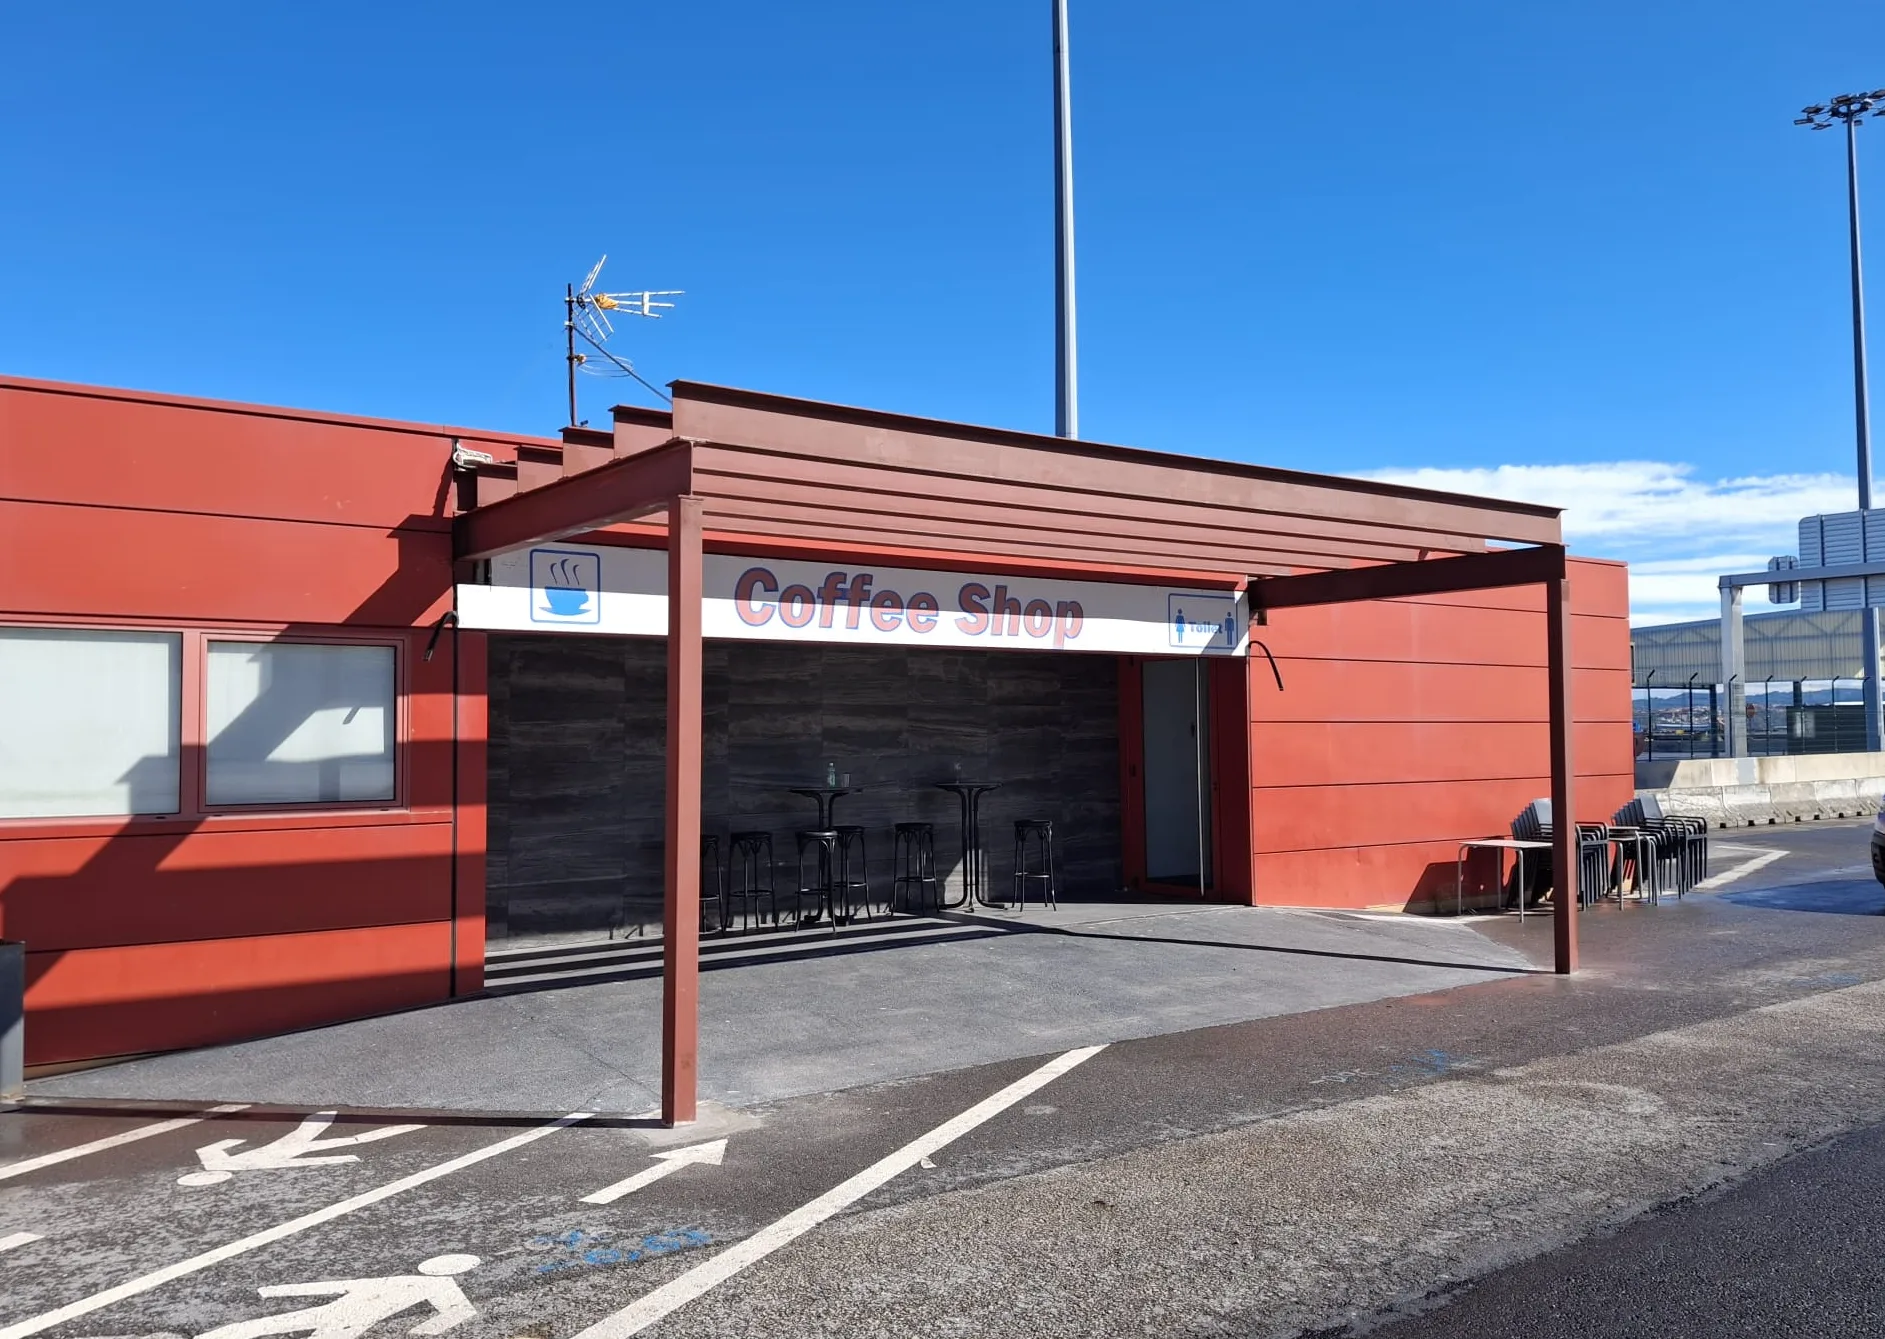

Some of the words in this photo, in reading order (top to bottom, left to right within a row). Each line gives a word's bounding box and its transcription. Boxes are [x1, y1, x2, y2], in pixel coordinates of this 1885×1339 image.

[734, 566, 939, 633] Coffee
[954, 582, 1084, 649] Shop
[1187, 620, 1223, 634] Toilet
